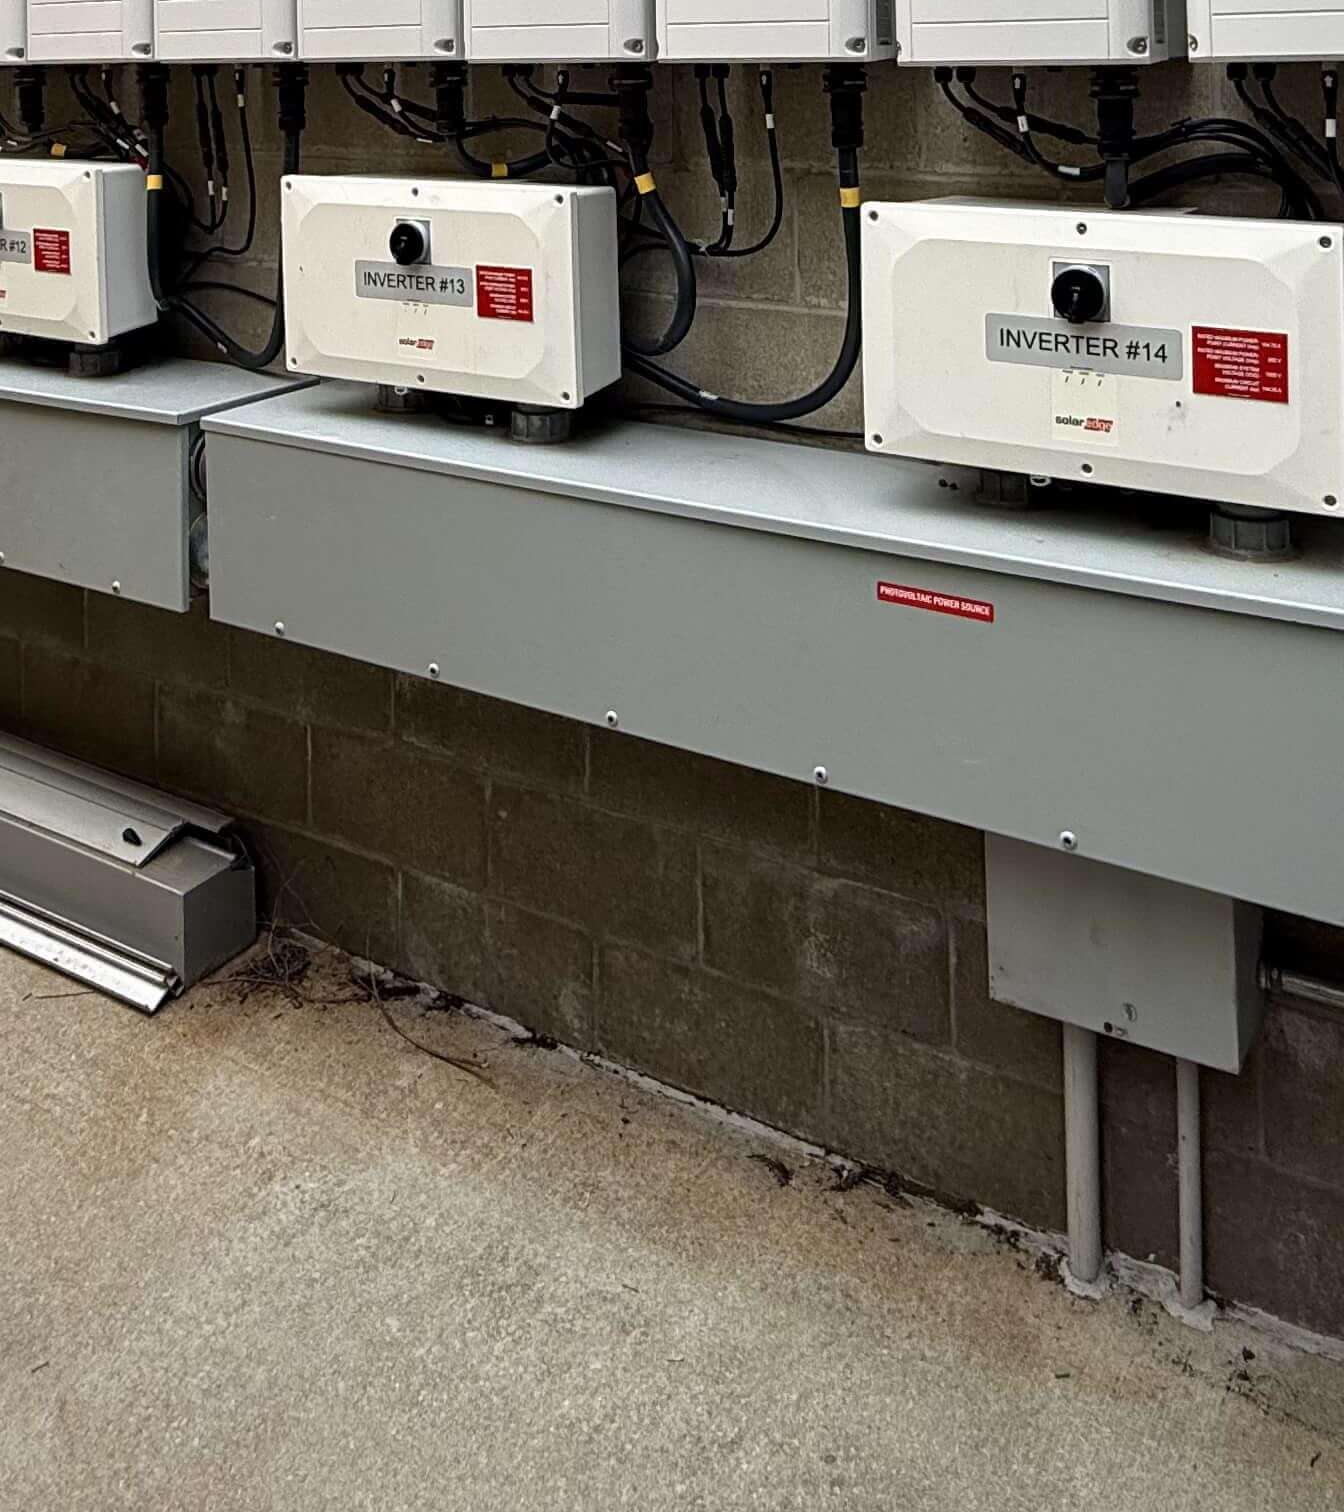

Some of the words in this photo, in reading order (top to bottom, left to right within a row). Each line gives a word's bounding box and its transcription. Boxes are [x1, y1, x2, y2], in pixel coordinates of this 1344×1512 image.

[8, 239, 27, 254] #12
[363, 271, 436, 292] INVERTER
[439, 277, 465, 294] #13
[999, 327, 1119, 359] INVERTER
[1125, 340, 1168, 363] #14
[879, 585, 932, 604] PHOTOVOLTAIC
[933, 596, 960, 609] POWER
[960, 601, 990, 616] SOURCE
